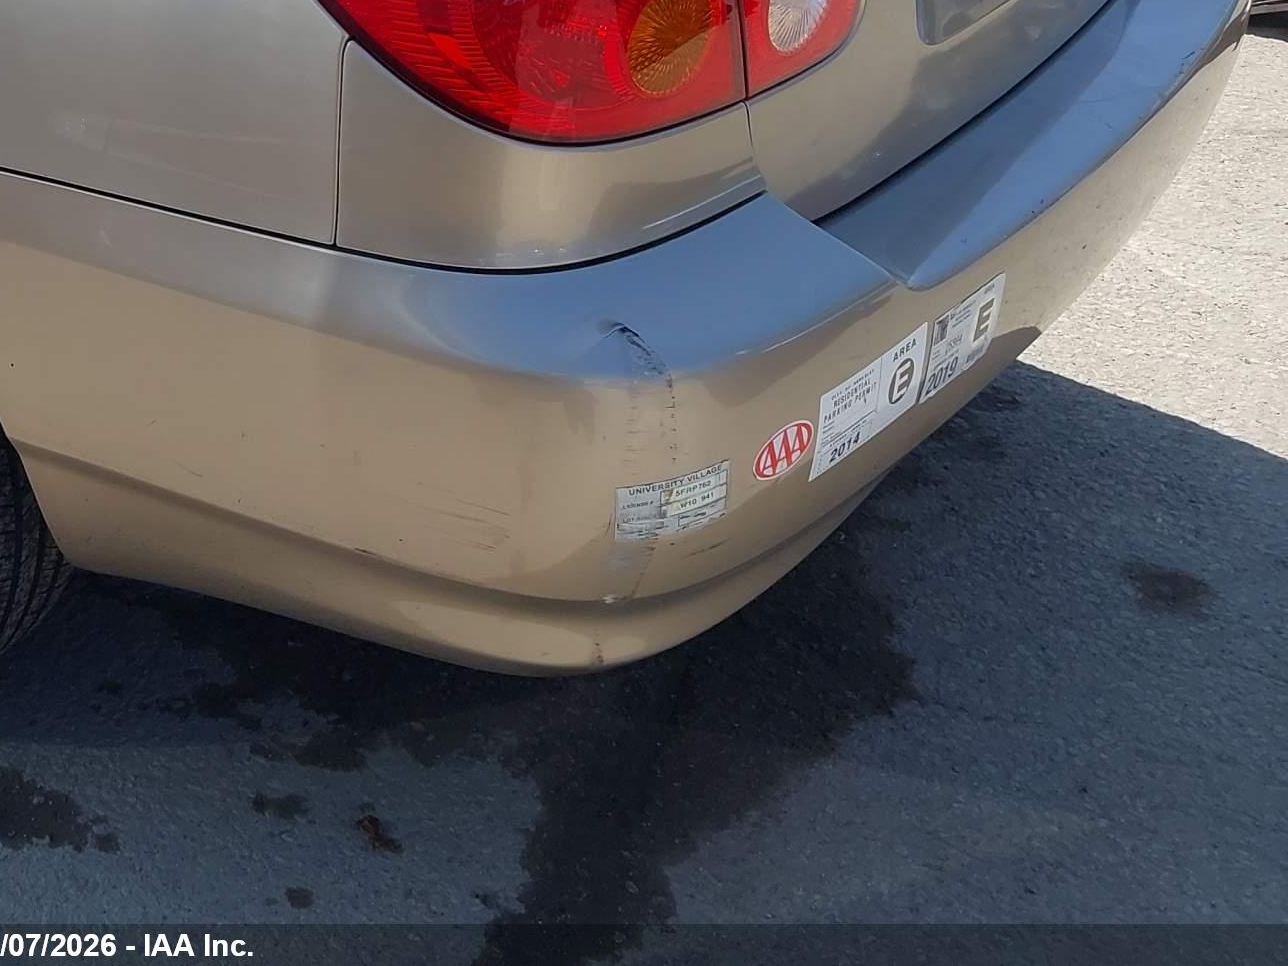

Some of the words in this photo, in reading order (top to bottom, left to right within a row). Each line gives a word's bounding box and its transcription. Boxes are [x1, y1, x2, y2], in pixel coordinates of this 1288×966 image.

[973, 297, 995, 343] E
[892, 338, 917, 362] AREA
[833, 378, 871, 407] RESIDENTIAL
[892, 360, 914, 403] E
[925, 356, 958, 396] 2019
[823, 395, 853, 423] PARKING
[854, 381, 877, 403] PERMIT
[756, 423, 810, 477] AAA
[829, 432, 861, 463] 2014
[628, 479, 685, 496] UNIVERSITY
[686, 465, 722, 483] VILLAGE
